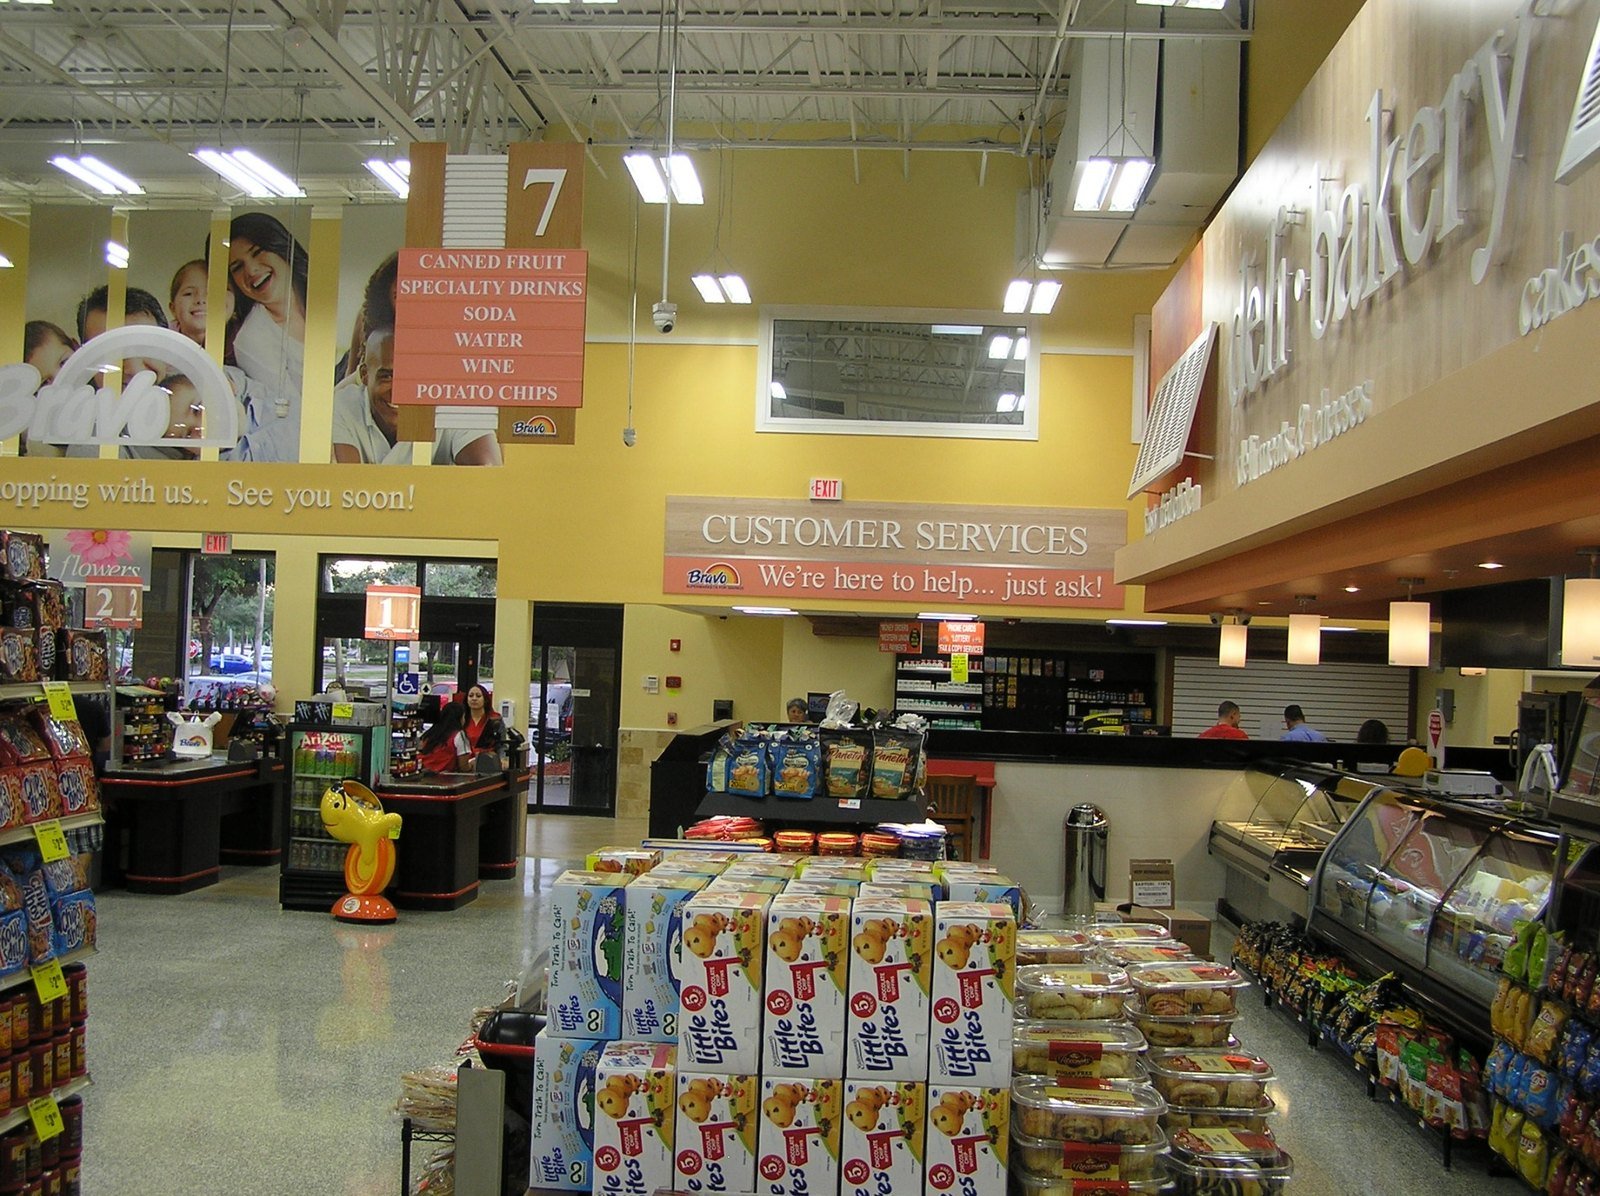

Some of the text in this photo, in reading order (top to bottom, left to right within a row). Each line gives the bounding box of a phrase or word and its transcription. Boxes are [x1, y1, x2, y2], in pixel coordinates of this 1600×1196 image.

[1310, 2, 1535, 340] bakery
[523, 168, 567, 237] 7
[419, 254, 566, 270] CANNED FRUIT
[400, 279, 583, 297] SPECIALTY DRINKS
[463, 306, 516, 322] SODA
[455, 332, 523, 348] WATER
[462, 359, 514, 374] WINE
[416, 384, 558, 401] POTATO CHIPS
[512, 421, 546, 434] Bravo
[99, 477, 155, 505] with
[227, 479, 273, 507] See
[283, 487, 332, 514] you
[341, 484, 416, 511] soon!
[815, 479, 838, 499] EXIT
[205, 535, 228, 552] EXIT
[702, 514, 1088, 556] CUSTOMER SERVICES
[60, 554, 140, 578] flowers
[688, 569, 727, 584] Bravo
[757, 563, 1103, 602] We're here to help... just ask!
[96, 587, 113, 616] 2
[129, 588, 137, 616] 2
[379, 597, 395, 628] 1
[410, 600, 416, 628] 1
[552, 931, 561, 940] To
[627, 935, 636, 944] To
[551, 944, 560, 966] Trash
[626, 948, 635, 970] Trash
[551, 970, 559, 988] Turn
[626, 974, 634, 992] Turn
[569, 995, 584, 1024] Bites
[684, 994, 699, 1005] 5
[770, 998, 785, 1009] 5
[854, 1001, 869, 1012] 5
[557, 1004, 576, 1031] Little
[633, 1008, 652, 1035] Little
[644, 999, 660, 1027] Bites
[937, 1006, 952, 1017] 5
[709, 999, 738, 1051] Bites
[796, 1002, 824, 1055] Bites
[880, 1004, 908, 1057] Bites
[688, 1015, 723, 1064] Little
[774, 1018, 809, 1069] Little
[858, 1021, 893, 1072] Little
[963, 1010, 991, 1063] Bites
[942, 1027, 976, 1077] Little
[536, 1084, 544, 1093] To
[535, 1097, 543, 1118] Trash
[534, 1122, 542, 1139] Turn
[541, 1155, 560, 1182] Little
[552, 1147, 567, 1175] Bites
[598, 1154, 613, 1166] 5
[680, 1158, 694, 1170] 5
[763, 1164, 778, 1174] 5
[624, 1158, 648, 1196] ites
[707, 1162, 727, 1192] tes
[789, 1168, 809, 1196] tes
[847, 1168, 862, 1178] 5
[932, 1172, 946, 1183] 5
